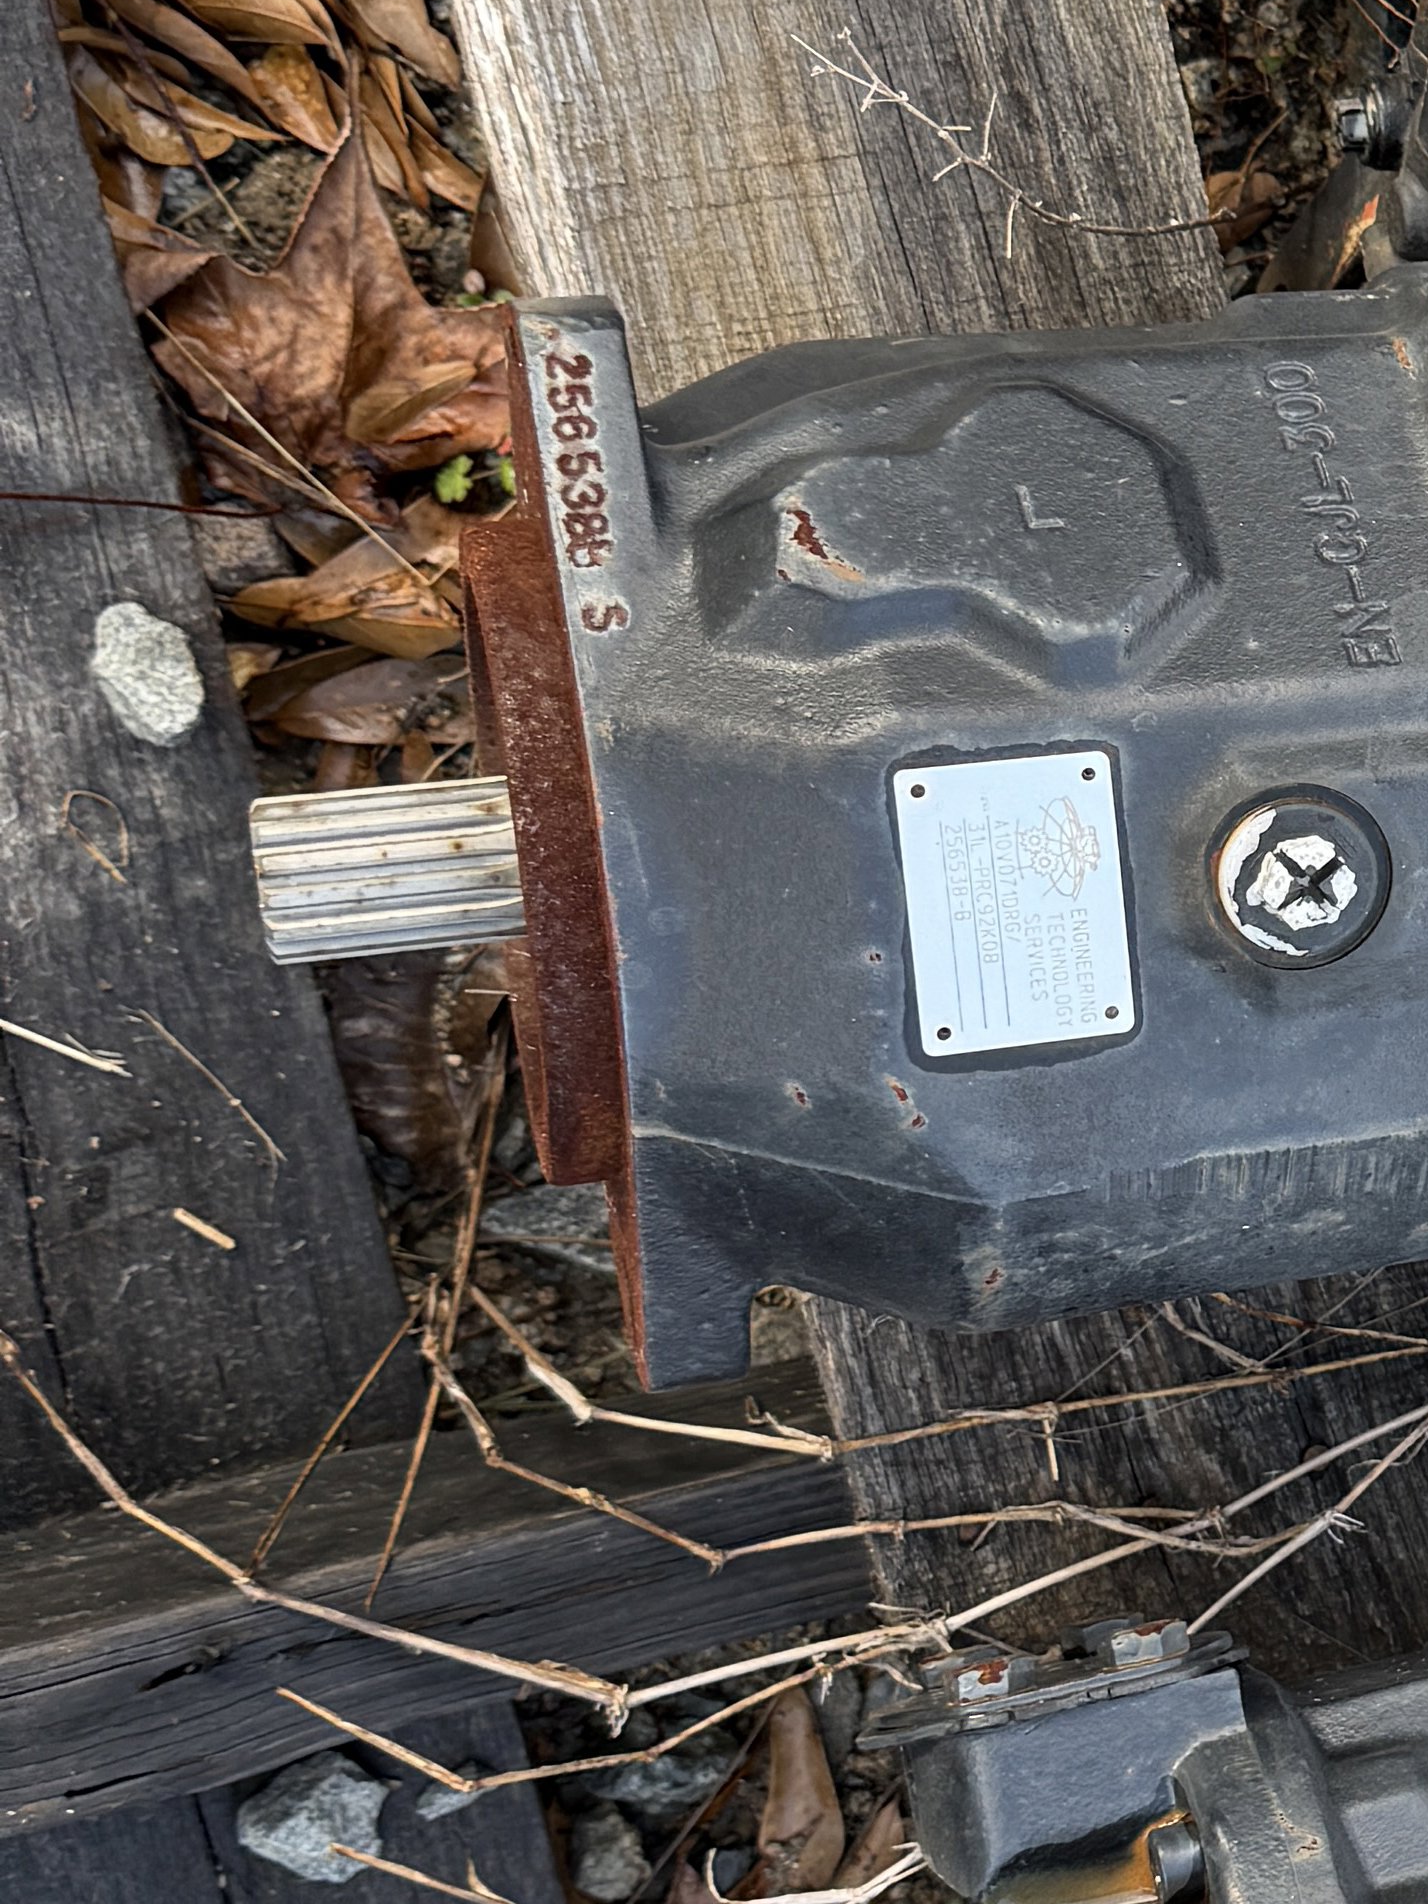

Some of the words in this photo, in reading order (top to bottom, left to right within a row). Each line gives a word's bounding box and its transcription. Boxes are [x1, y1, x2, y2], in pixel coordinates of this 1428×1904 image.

[1023, 913, 1048, 1002] SERVICES
[1046, 911, 1074, 1027] TECHNOLOGY
[1070, 908, 1098, 1024] ENGINEERING
